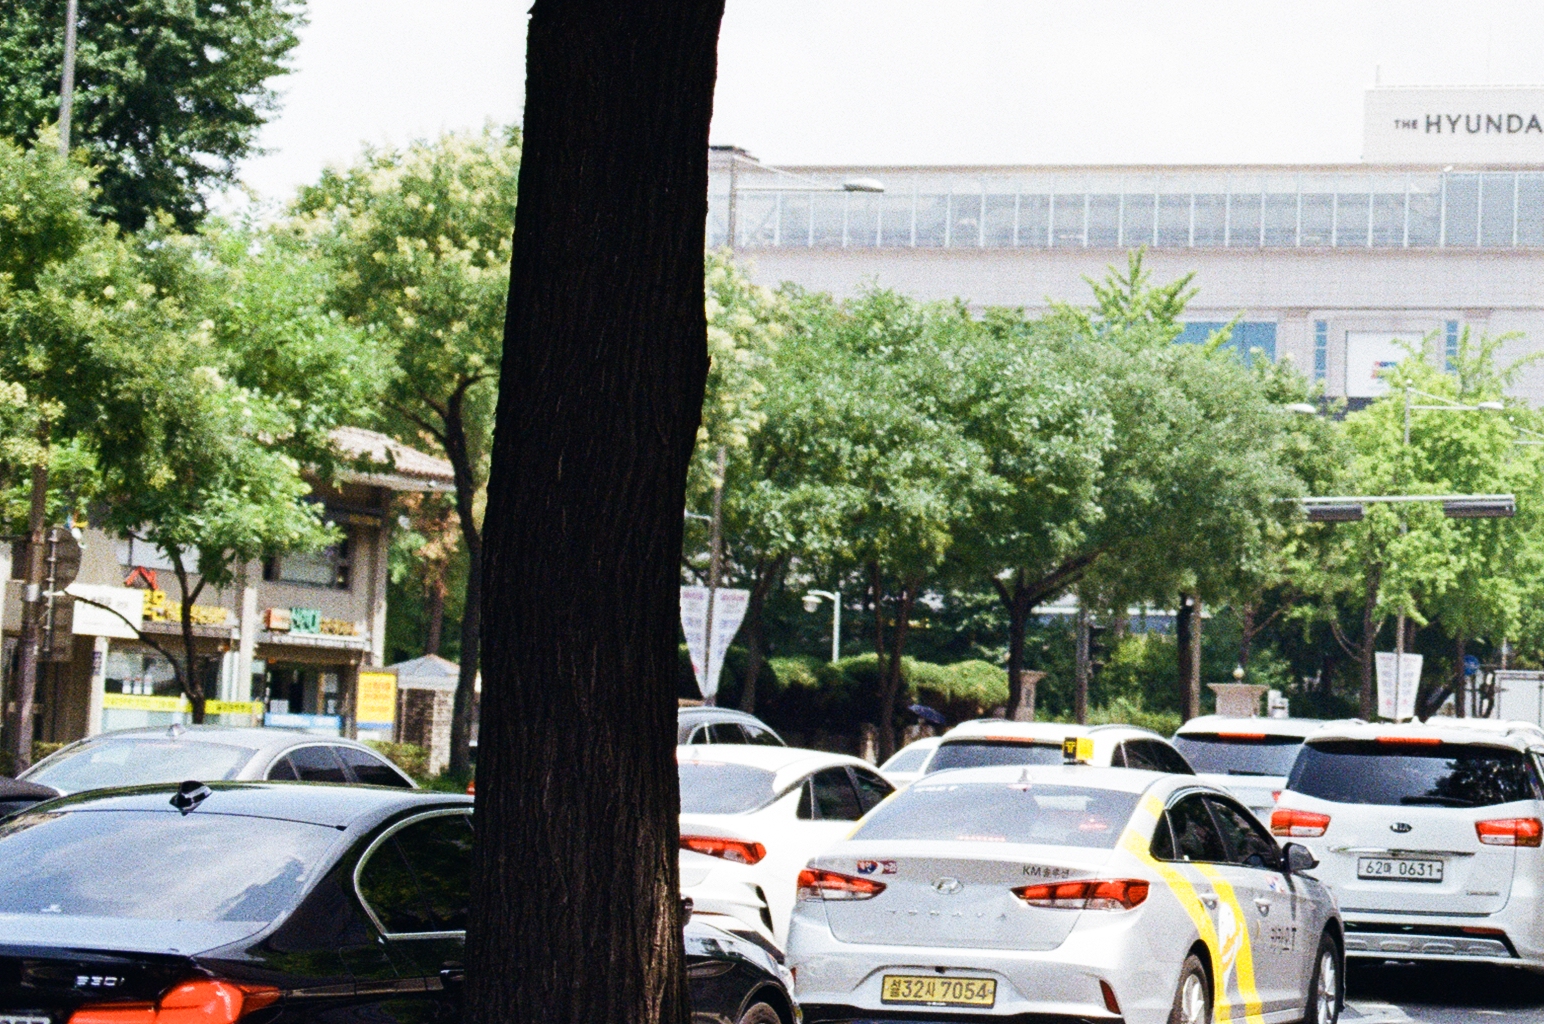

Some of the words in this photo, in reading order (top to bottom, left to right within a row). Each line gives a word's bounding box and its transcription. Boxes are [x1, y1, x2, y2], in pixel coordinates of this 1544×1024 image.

[1394, 119, 1418, 130] THE
[1399, 862, 1433, 876] 0631
[941, 982, 987, 1000] 7054
